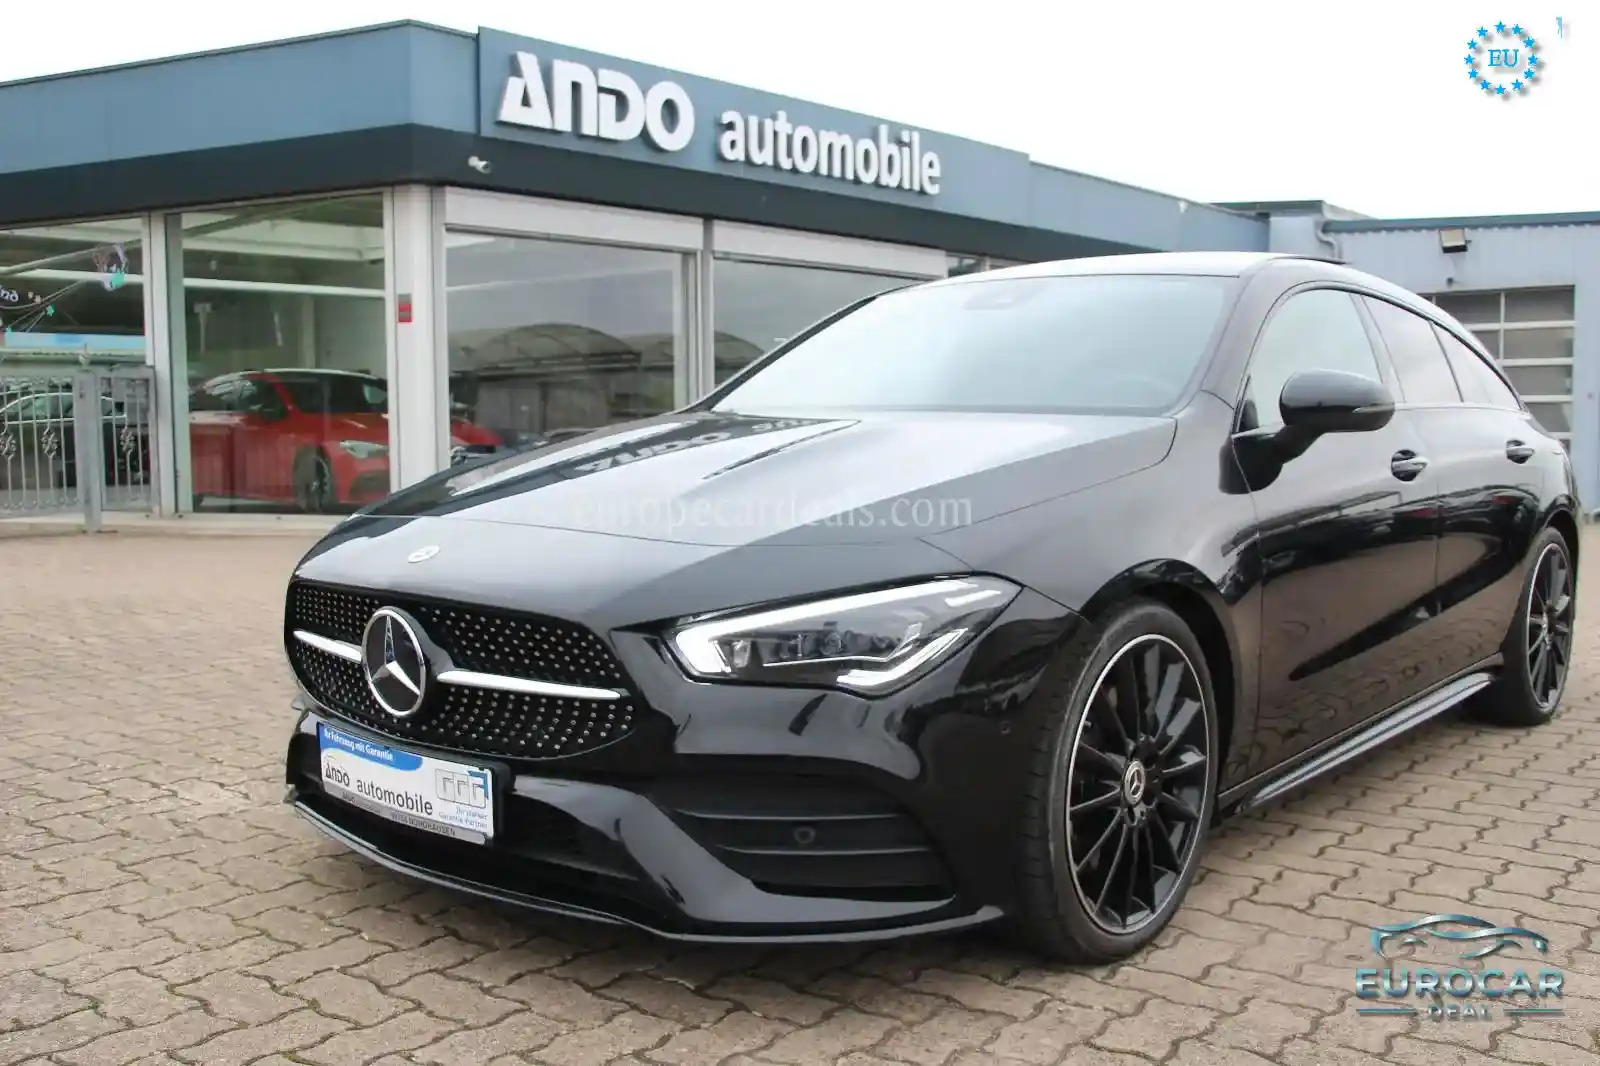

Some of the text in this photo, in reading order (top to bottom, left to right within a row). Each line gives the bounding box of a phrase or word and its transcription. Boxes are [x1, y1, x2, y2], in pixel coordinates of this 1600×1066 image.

[717, 107, 942, 196] automobile
[366, 744, 394, 761] Garantie
[356, 778, 433, 815] automobile
